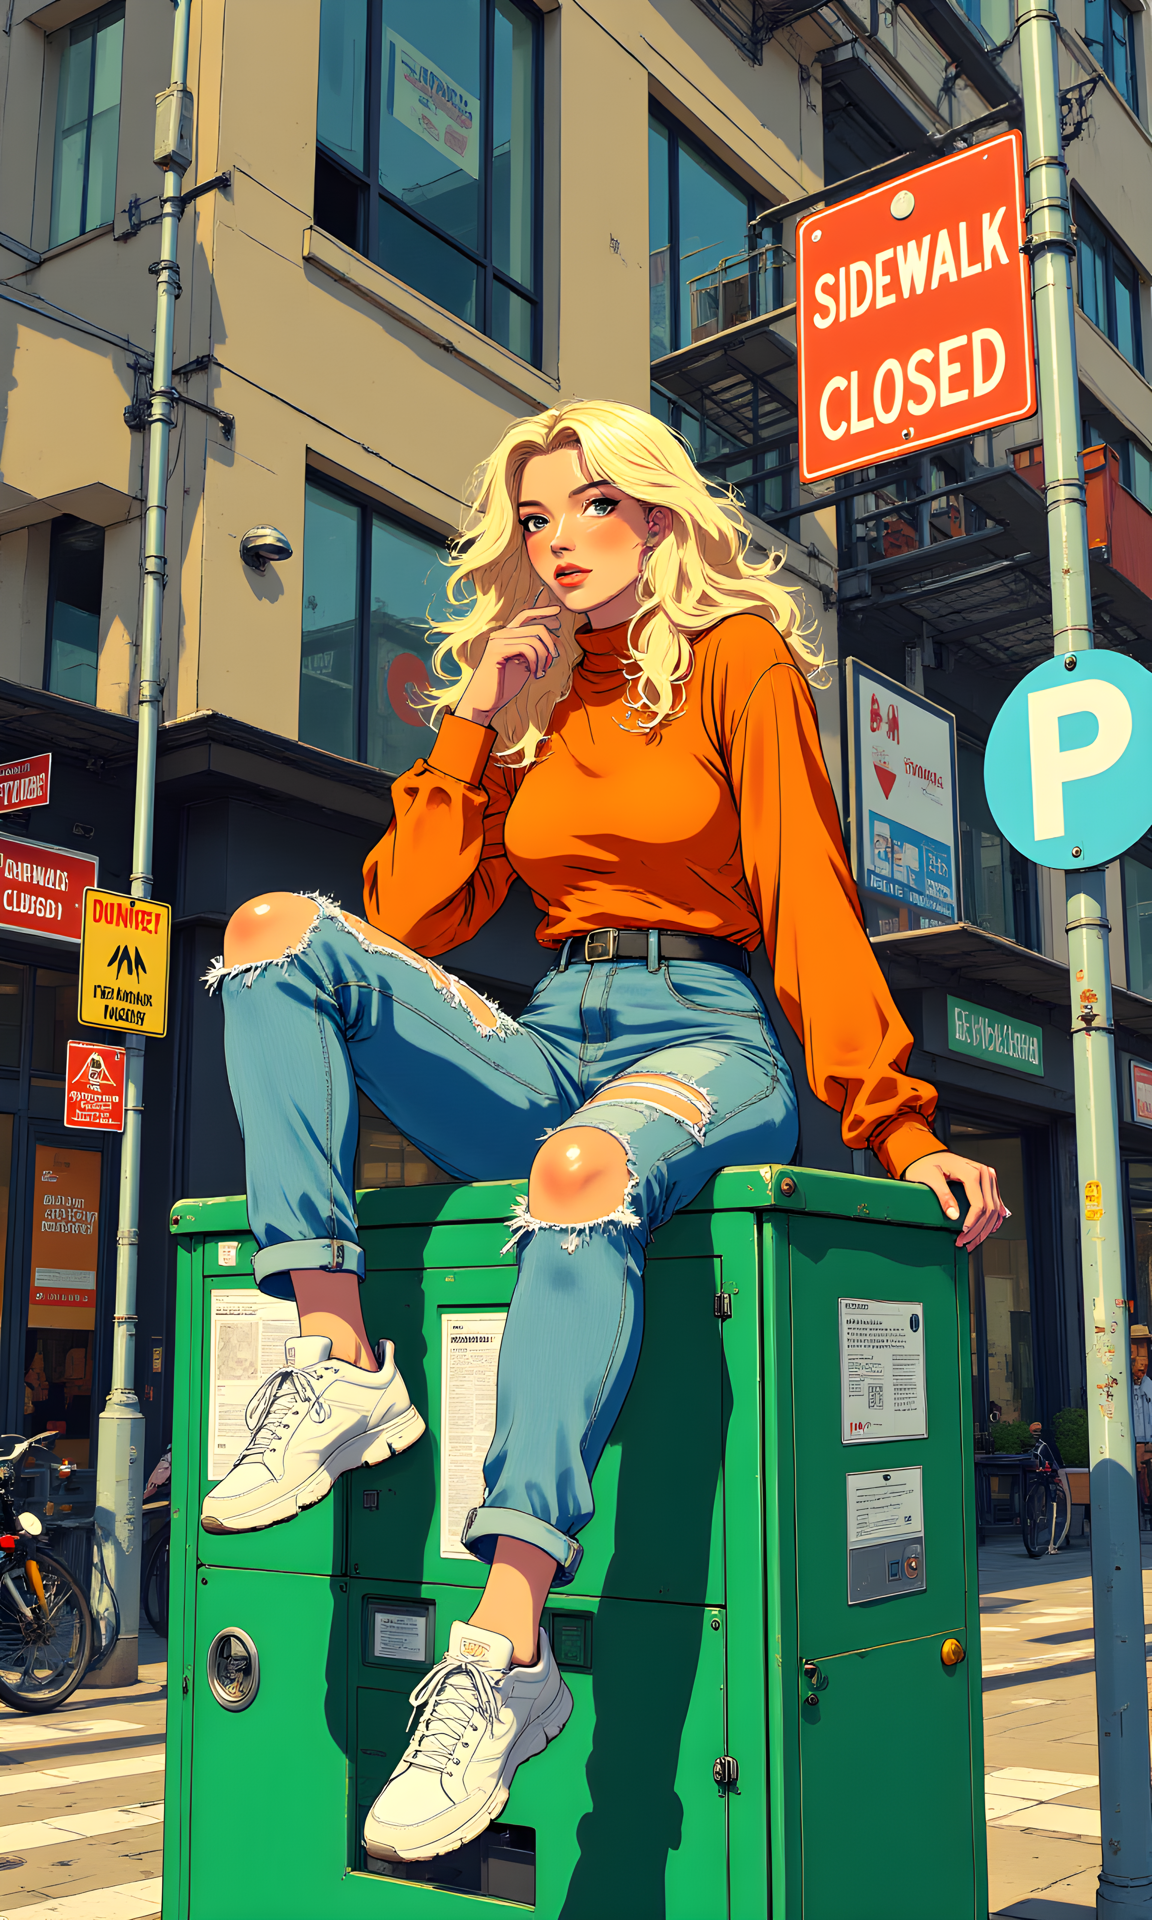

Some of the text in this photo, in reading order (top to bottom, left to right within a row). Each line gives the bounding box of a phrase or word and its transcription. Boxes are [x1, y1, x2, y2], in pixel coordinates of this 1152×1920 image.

[813, 206, 1010, 330] SIDEWALK
[819, 327, 1006, 441] CLOSED
[1027, 678, 1133, 842] P
